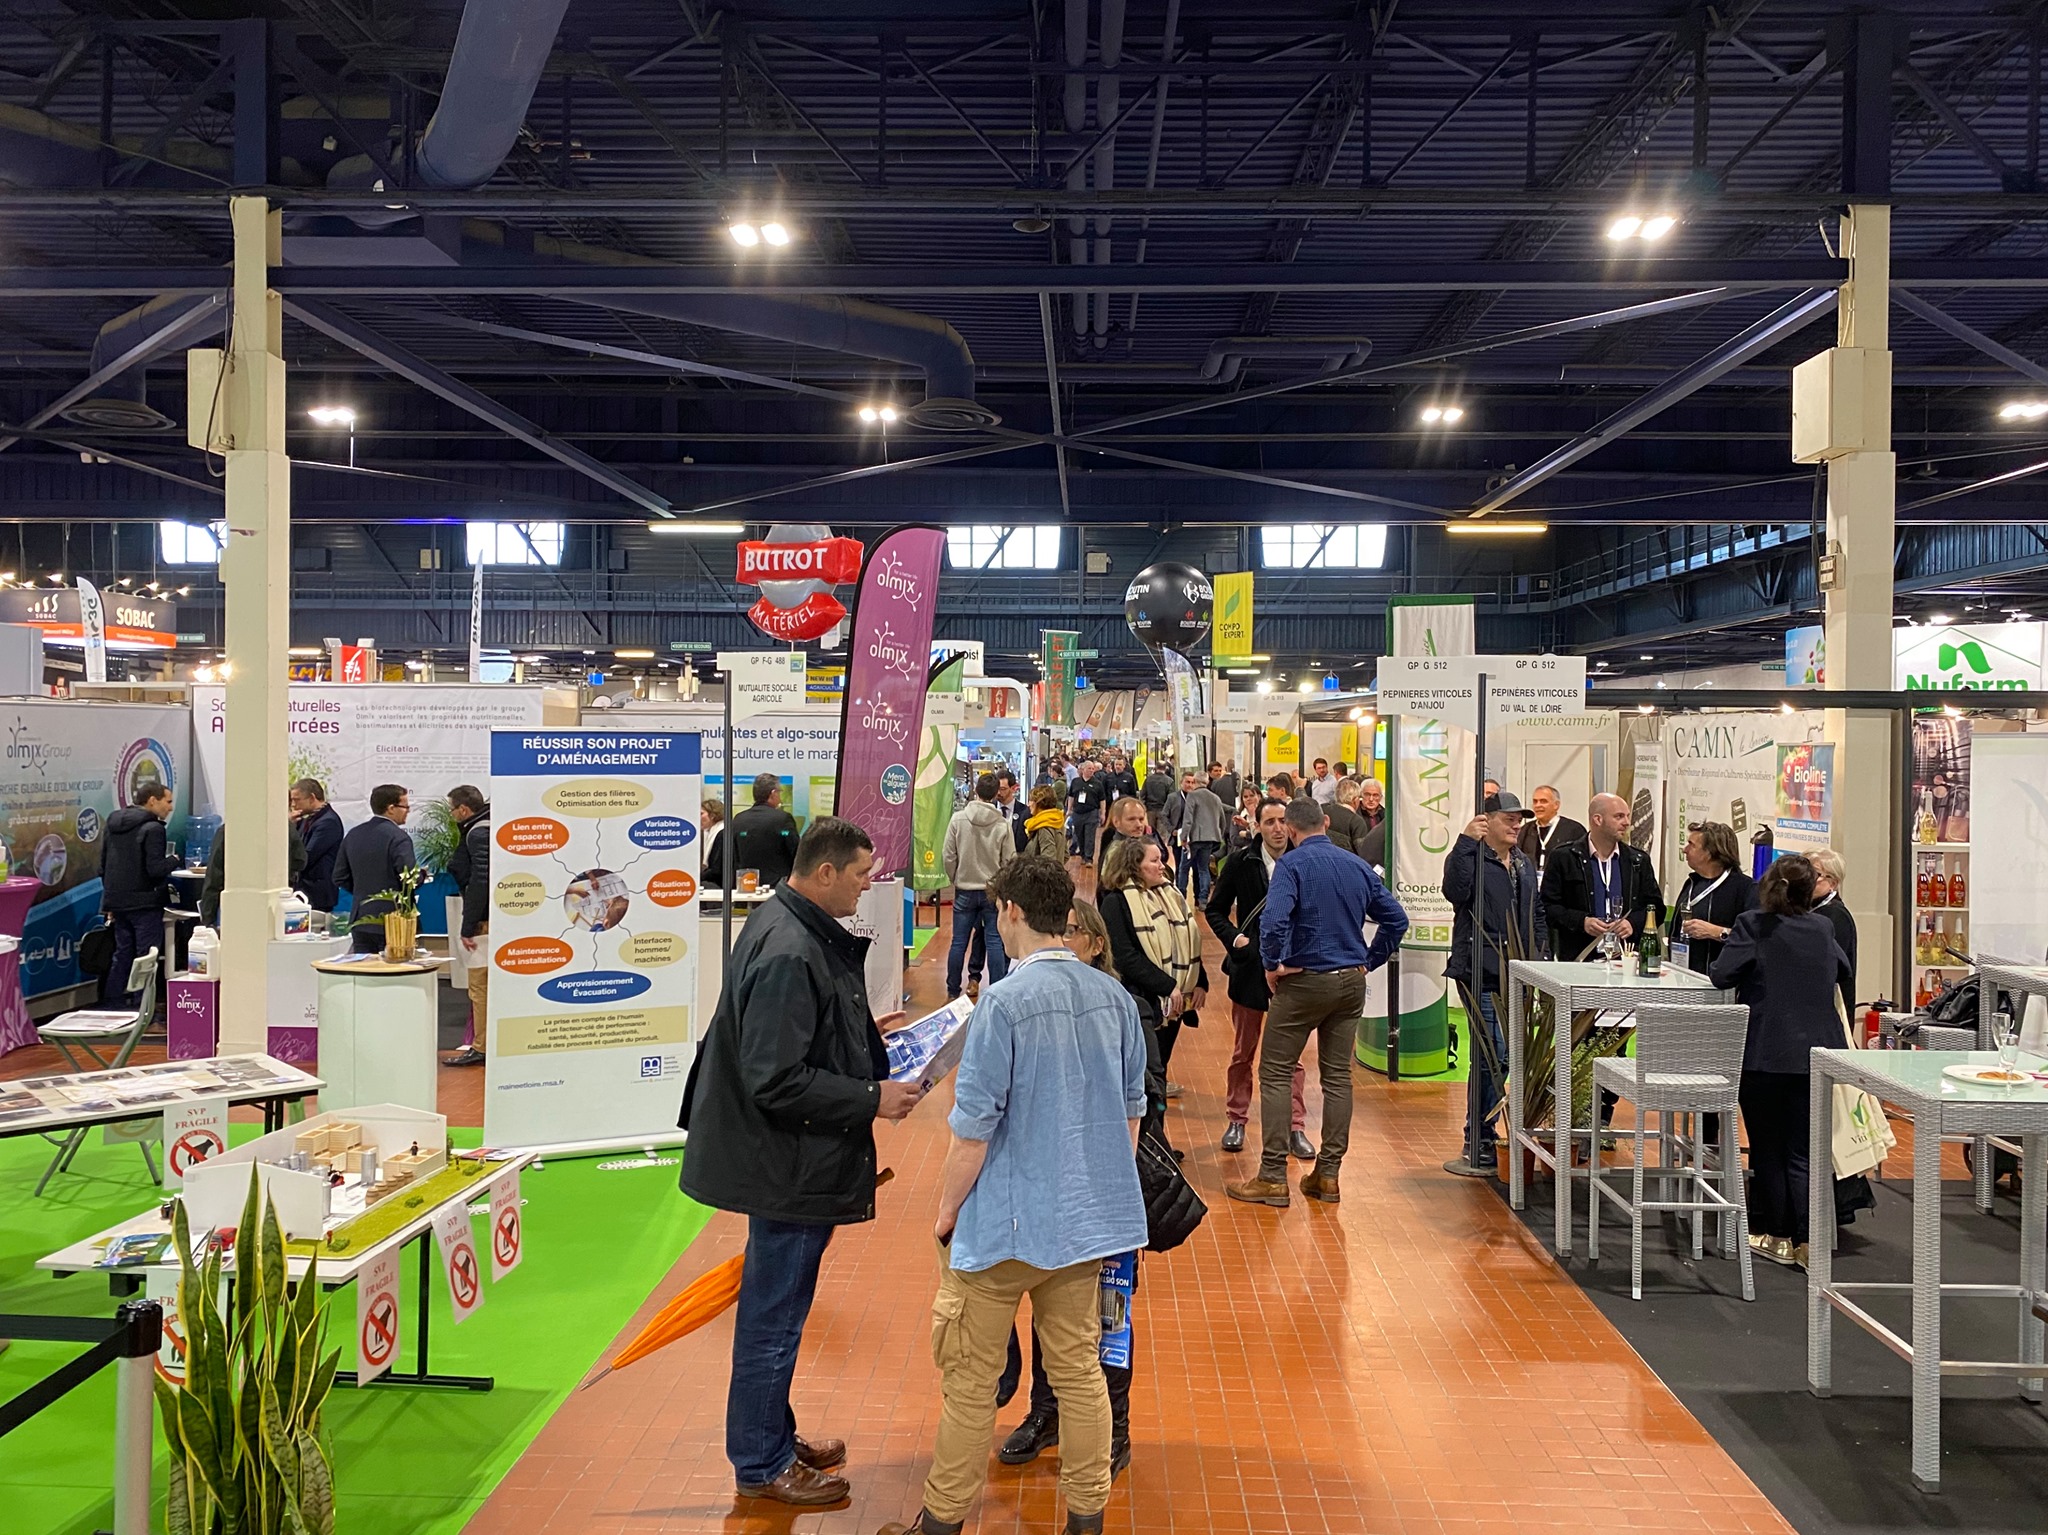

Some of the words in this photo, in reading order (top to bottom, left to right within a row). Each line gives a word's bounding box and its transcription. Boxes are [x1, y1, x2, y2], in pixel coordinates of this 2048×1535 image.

[744, 547, 828, 572] BUTROT
[116, 606, 155, 629] SOBAC
[1219, 622, 1240, 631] COMPO
[1224, 630, 1245, 639] EXPERT
[750, 656, 760, 665] GP
[762, 656, 773, 665] F-G
[775, 656, 786, 665] 488
[1407, 661, 1419, 670] GP
[1423, 661, 1430, 670] G
[1433, 661, 1448, 670] 512
[1515, 660, 1527, 669] GP
[1531, 660, 1538, 669] G
[1541, 660, 1555, 669] 512
[1906, 673, 2029, 691] Nufarm
[738, 684, 771, 692] MUTUALITE
[771, 683, 798, 692] SOCIALE
[1383, 690, 1430, 698] PEPINIERES
[1431, 689, 1472, 698] VITICOLES
[1536, 688, 1578, 698] VITICOLES
[752, 694, 783, 703] AGRICOLE
[288, 699, 341, 713] aturelles
[371, 704, 426, 713] biotechnologies
[429, 704, 473, 713] développées
[1410, 701, 1445, 710] D'ANJOU
[1500, 704, 1511, 713] DU
[1513, 704, 1526, 713] VAL
[1529, 704, 1538, 713] DE
[1540, 704, 1562, 713] LOIRE
[431, 713, 468, 722] propriétés
[471, 713, 526, 721] nutritionnelles,
[1516, 714, 1611, 729] www.camn.fr
[761, 728, 773, 739] et
[776, 726, 839, 742] algo-sour
[523, 735, 583, 750] RÉUSSIR
[587, 738, 616, 749] SON
[620, 738, 672, 750] PROJET
[1674, 726, 1737, 759] CAMN
[42, 743, 72, 760] Group
[777, 748, 790, 759] et
[793, 746, 804, 759] le
[537, 751, 658, 765] D'AMÉNAGEMENT
[887, 772, 905, 781] Merci
[1793, 765, 1827, 784] Bioline
[82, 780, 104, 791] GROUP
[1418, 718, 1450, 854] CAMN
[560, 790, 591, 798] Gestion
[609, 789, 635, 797] filières
[556, 799, 607, 808] Optimisation
[512, 823, 530, 831] Lien
[634, 829, 681, 837] industrielles
[507, 842, 558, 851] organisation
[643, 838, 681, 846] humaines
[497, 881, 542, 890] Opérations
[652, 880, 691, 888] Situations
[1396, 881, 1441, 896] Coopér
[651, 889, 692, 898] dégradées
[1395, 895, 1448, 903] d'approvisionn
[499, 900, 539, 909] nettoyage
[1432, 905, 1453, 913] spécia
[633, 937, 673, 945] Interfaces
[507, 946, 560, 955] Maintenance
[634, 945, 671, 954] hommes/
[518, 956, 567, 965] installations
[634, 955, 671, 963] machines
[556, 977, 634, 989] Approvisionnement
[572, 987, 617, 997] Évacuation
[553, 1018, 570, 1026] prise
[581, 1016, 606, 1025] compte
[559, 1023, 595, 1032] facteur-clé
[605, 1021, 646, 1030] performance
[570, 1031, 598, 1040] sécurité,
[599, 1029, 640, 1038] productivité,
[527, 1042, 552, 1050] fiabilité
[566, 1040, 593, 1048] process
[602, 1036, 624, 1045] qualité
[634, 1034, 659, 1043] produit.
[497, 1079, 565, 1090] maineetloire.msa.fr
[187, 1107, 206, 1117] SVP
[175, 1117, 219, 1129] FRAGILE
[500, 1180, 511, 1192] SVP
[494, 1189, 517, 1211] FRAGILE
[447, 1215, 458, 1228] SVP
[443, 1225, 468, 1247] FRAGILE
[373, 1261, 387, 1277] SVP
[365, 1271, 395, 1298] FRAGILE
[1115, 1277, 1129, 1287] NOS
